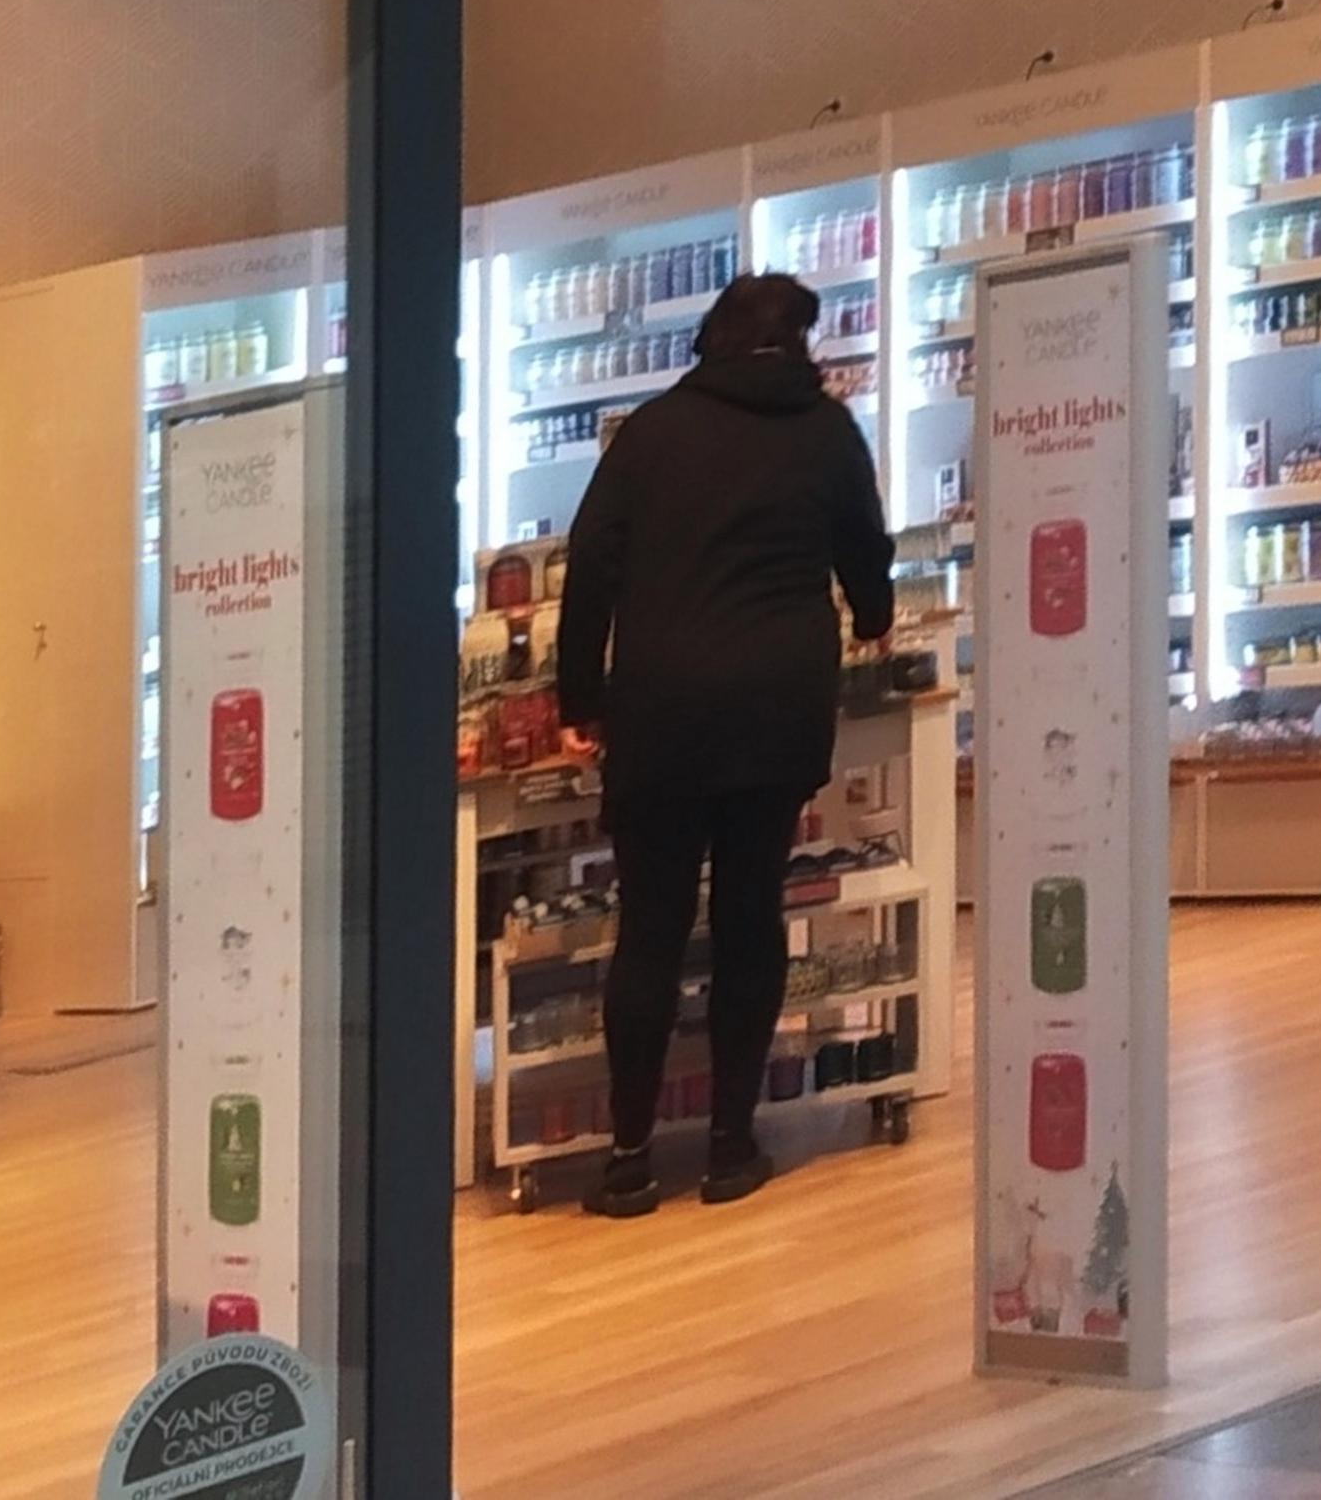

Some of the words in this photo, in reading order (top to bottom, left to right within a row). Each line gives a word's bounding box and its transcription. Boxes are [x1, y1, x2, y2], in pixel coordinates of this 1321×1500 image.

[992, 404, 1058, 438] bright
[1064, 395, 1126, 430] lights
[174, 557, 238, 597] bright
[243, 550, 300, 589] lights
[204, 592, 273, 618] collection
[115, 1366, 188, 1453] GARANCE
[213, 1439, 295, 1477] PRODEJCE
